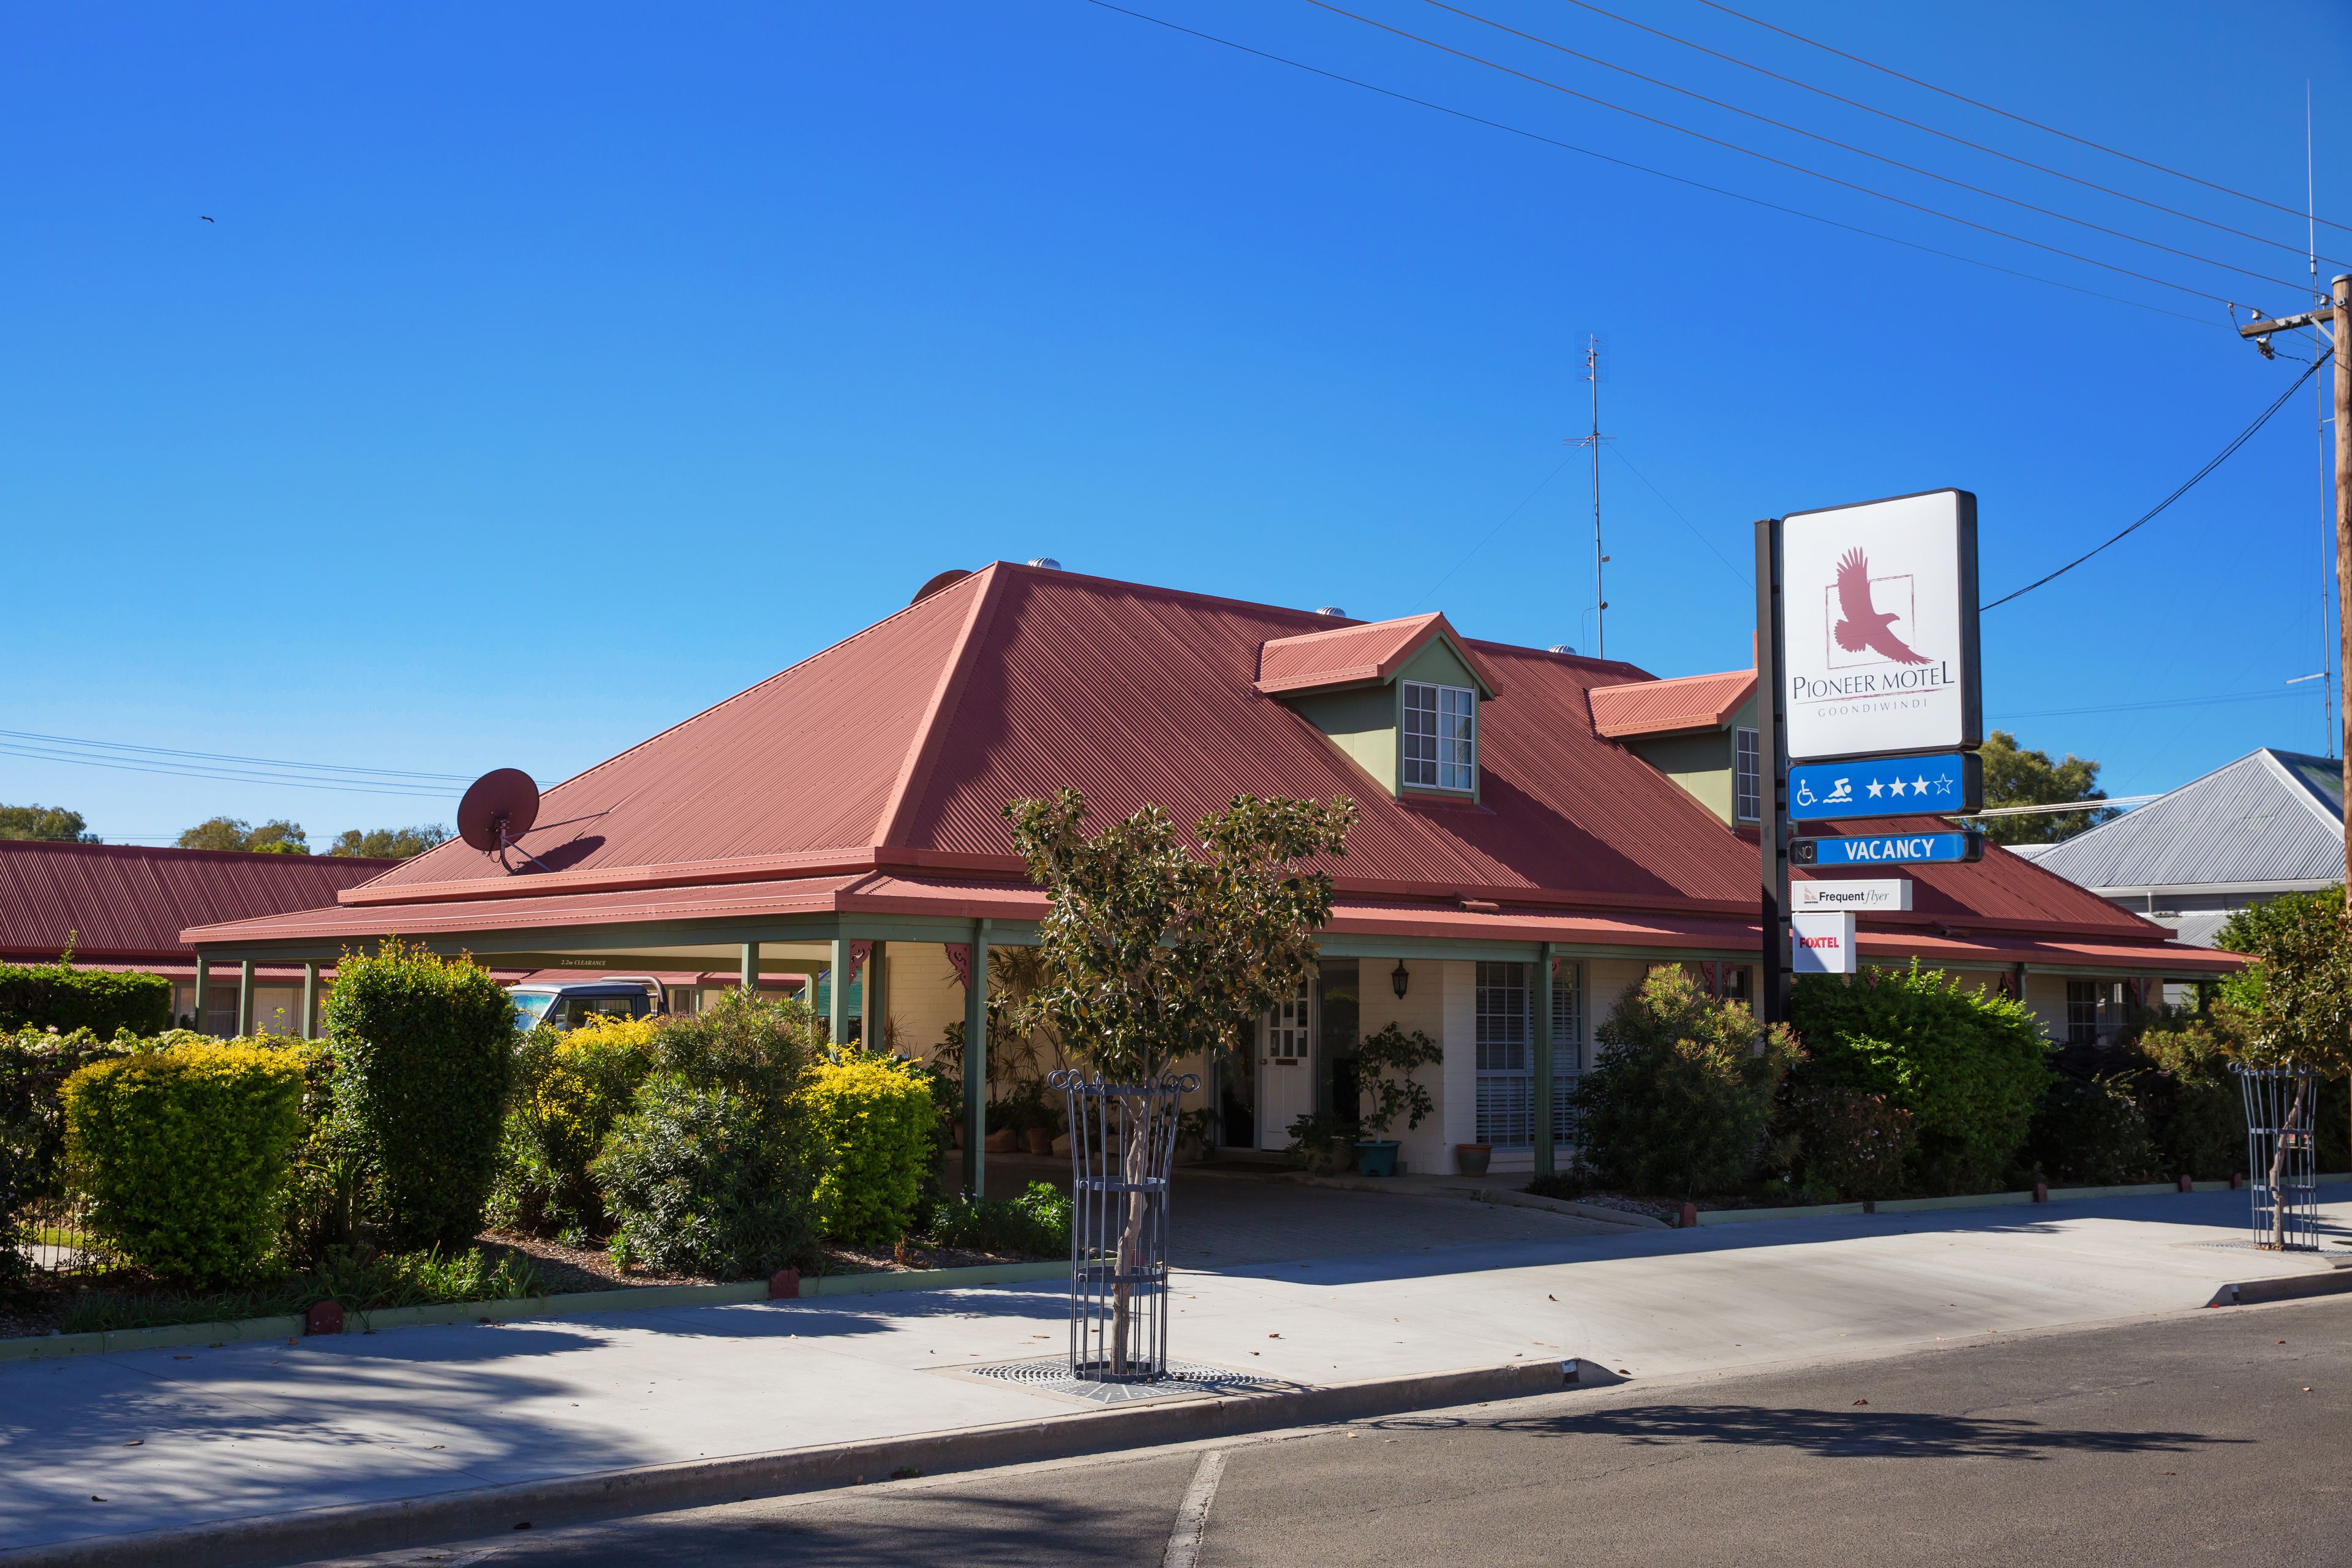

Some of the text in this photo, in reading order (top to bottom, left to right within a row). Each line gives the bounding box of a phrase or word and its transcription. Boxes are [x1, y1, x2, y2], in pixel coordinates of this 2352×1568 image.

[1793, 661, 1954, 699] PIONEER MOTEL
[1818, 699, 1926, 717] GOONDIWINDI
[1845, 839, 1935, 860] VACANCY
[1819, 889, 1889, 904] Frequent flyer
[1800, 937, 1839, 948] FOXTEL
